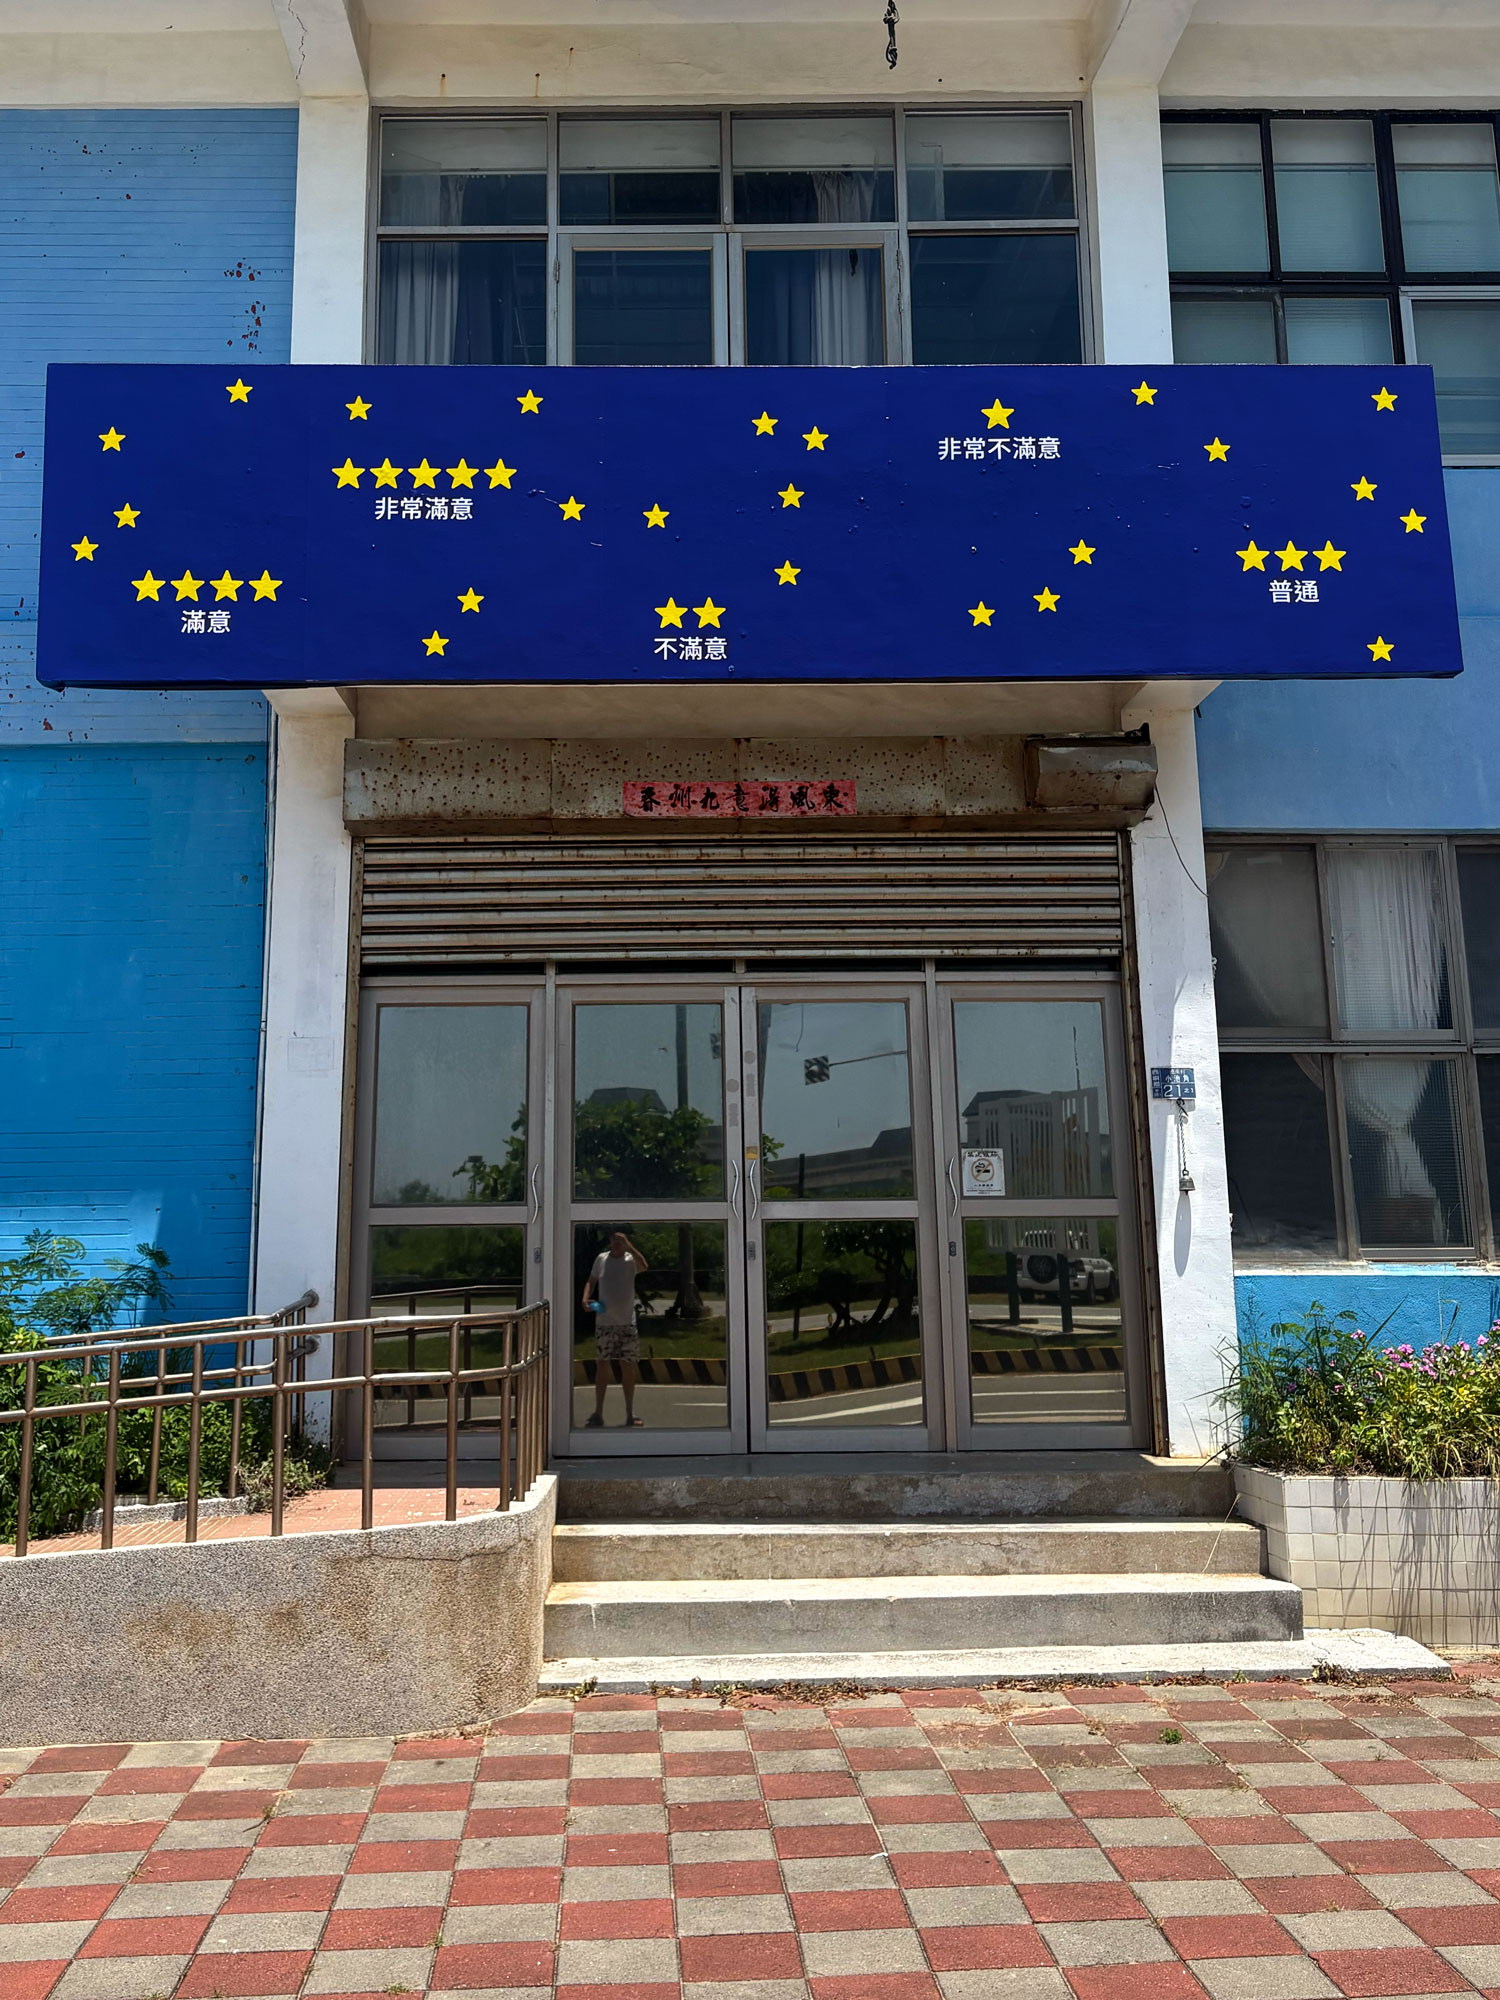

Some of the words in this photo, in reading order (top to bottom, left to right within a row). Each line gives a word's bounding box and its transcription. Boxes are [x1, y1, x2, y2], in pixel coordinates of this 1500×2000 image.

[938, 437, 1060, 460] 非常不滿意
[375, 497, 473, 520] 非常滿意
[1269, 580, 1319, 603] 普通
[181, 610, 231, 633] 滿意
[654, 637, 727, 660] 不滿意
